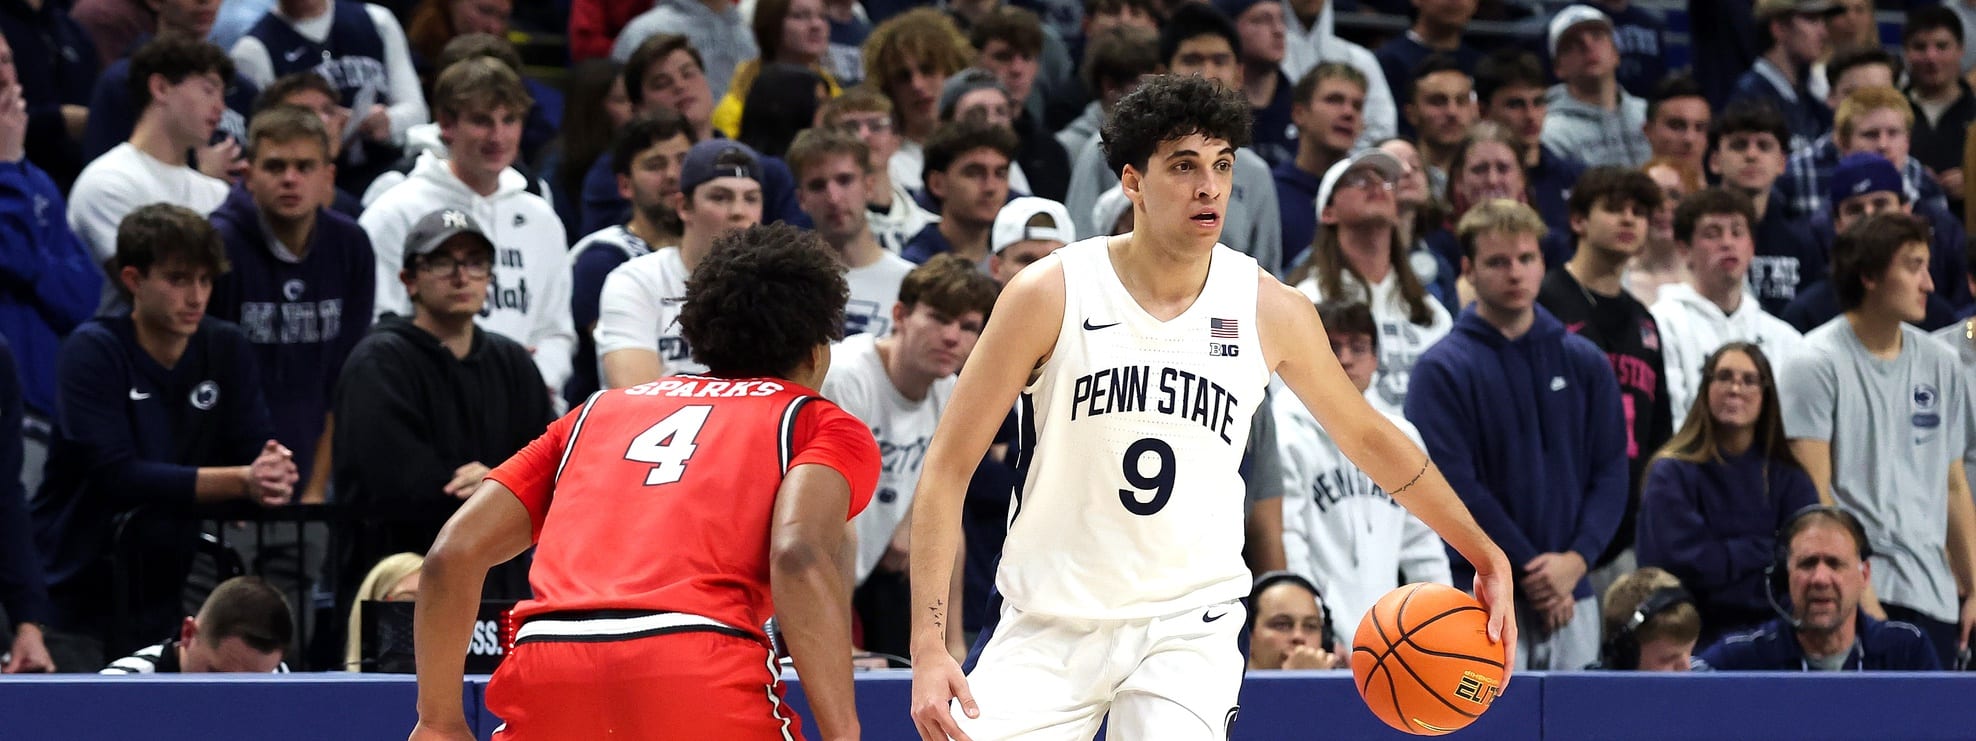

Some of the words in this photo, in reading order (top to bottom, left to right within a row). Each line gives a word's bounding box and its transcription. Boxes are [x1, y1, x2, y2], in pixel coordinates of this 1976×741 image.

[625, 380, 784, 398] SPARKS
[1071, 365, 1150, 421] PENN
[1158, 367, 1238, 445] STATE
[623, 404, 714, 486] 4
[1119, 438, 1176, 516] 9
[469, 620, 503, 656] SS.
